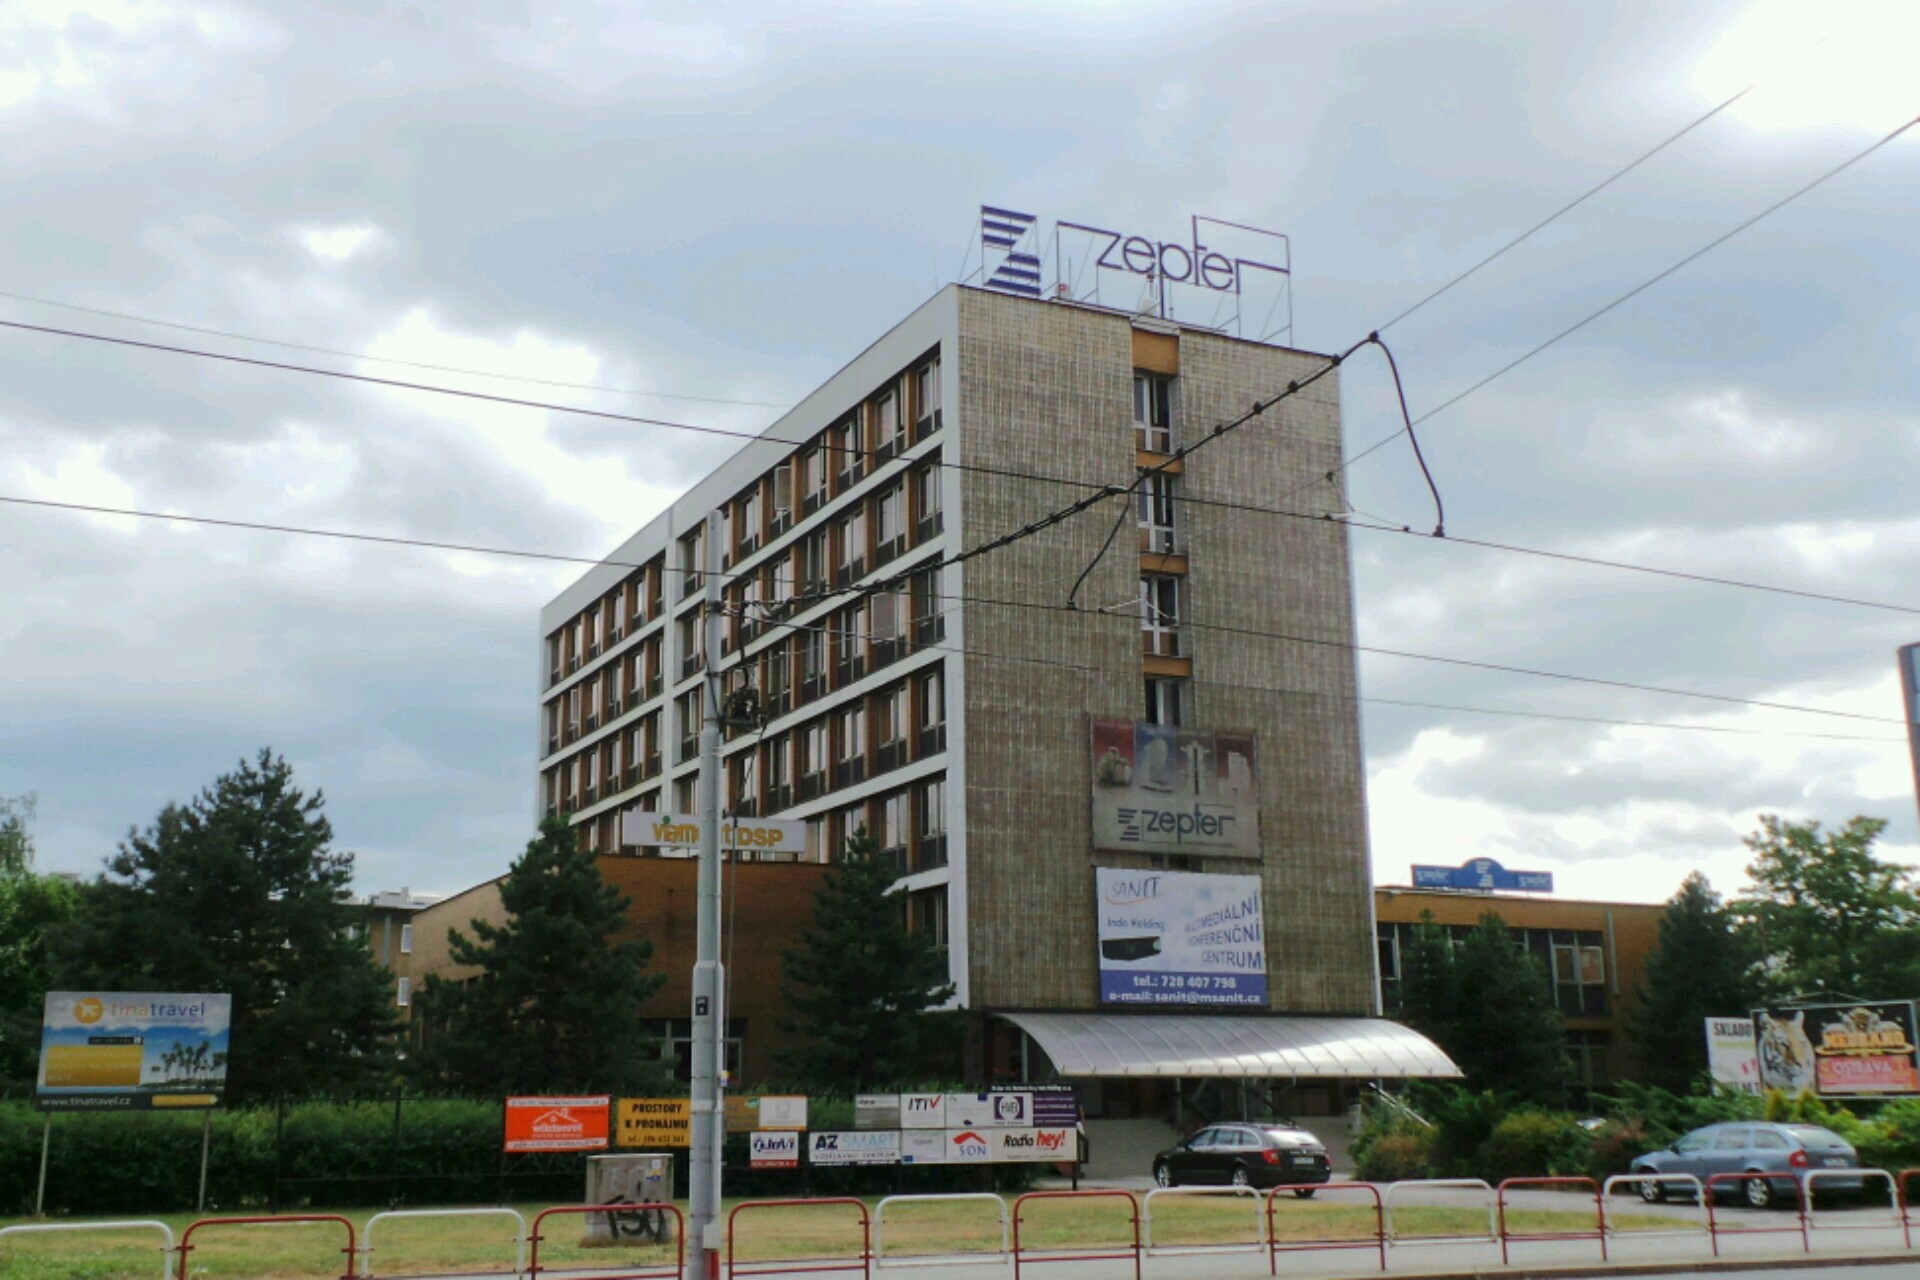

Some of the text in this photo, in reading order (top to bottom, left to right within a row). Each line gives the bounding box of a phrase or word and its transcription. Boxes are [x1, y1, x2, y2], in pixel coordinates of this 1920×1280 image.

[1057, 215, 1290, 318] zepter
[652, 815, 784, 848] viamt DSP
[1142, 803, 1236, 845] zepter
[1110, 876, 1162, 898] SANIT
[1200, 950, 1263, 971] CENTRUM
[1133, 975, 1158, 987] tel.:
[1161, 976, 1185, 988] 728
[1187, 977, 1210, 989] 407
[111, 1001, 205, 1017] tinatravel
[631, 1103, 682, 1114] PROSTORY
[815, 1135, 838, 1150] AZ
[841, 1133, 895, 1149] SMART
[1003, 1129, 1066, 1150] Radio hey!
[959, 1145, 987, 1156] SON
